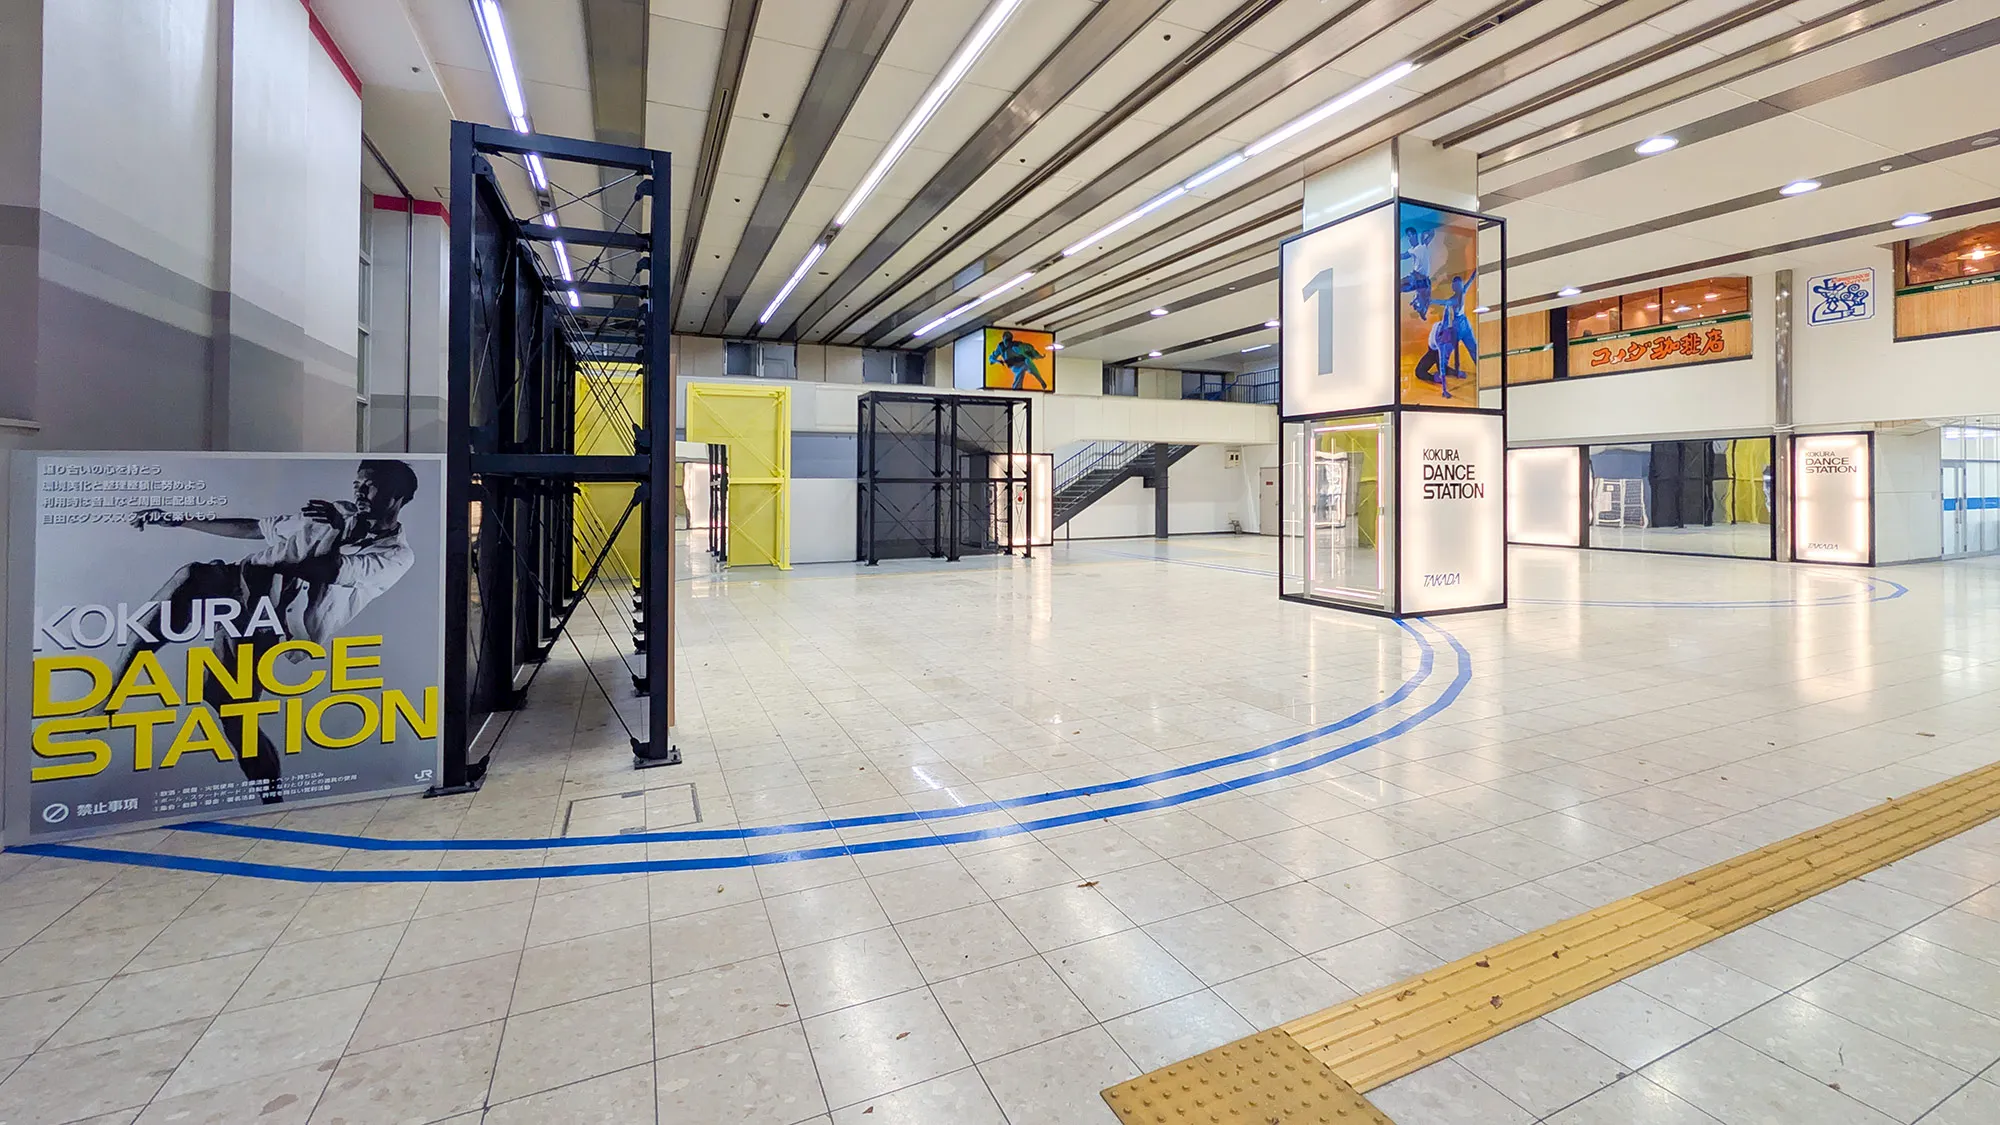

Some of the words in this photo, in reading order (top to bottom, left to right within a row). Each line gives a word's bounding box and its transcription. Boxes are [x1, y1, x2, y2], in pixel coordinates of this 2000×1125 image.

[1302, 267, 1334, 376] 1
[1423, 449, 1460, 461] KOKURA
[1805, 457, 1850, 466] DANCE
[1423, 464, 1475, 481] DANCE
[1805, 465, 1858, 474] STATION
[1423, 483, 1485, 499] STATION
[1423, 573, 1460, 587] TAKADA
[34, 596, 285, 653] KOKURA
[32, 636, 384, 718] DANCE
[32, 686, 438, 781] STATION
[414, 769, 433, 779] JR
[77, 798, 139, 817] 禁止事項
